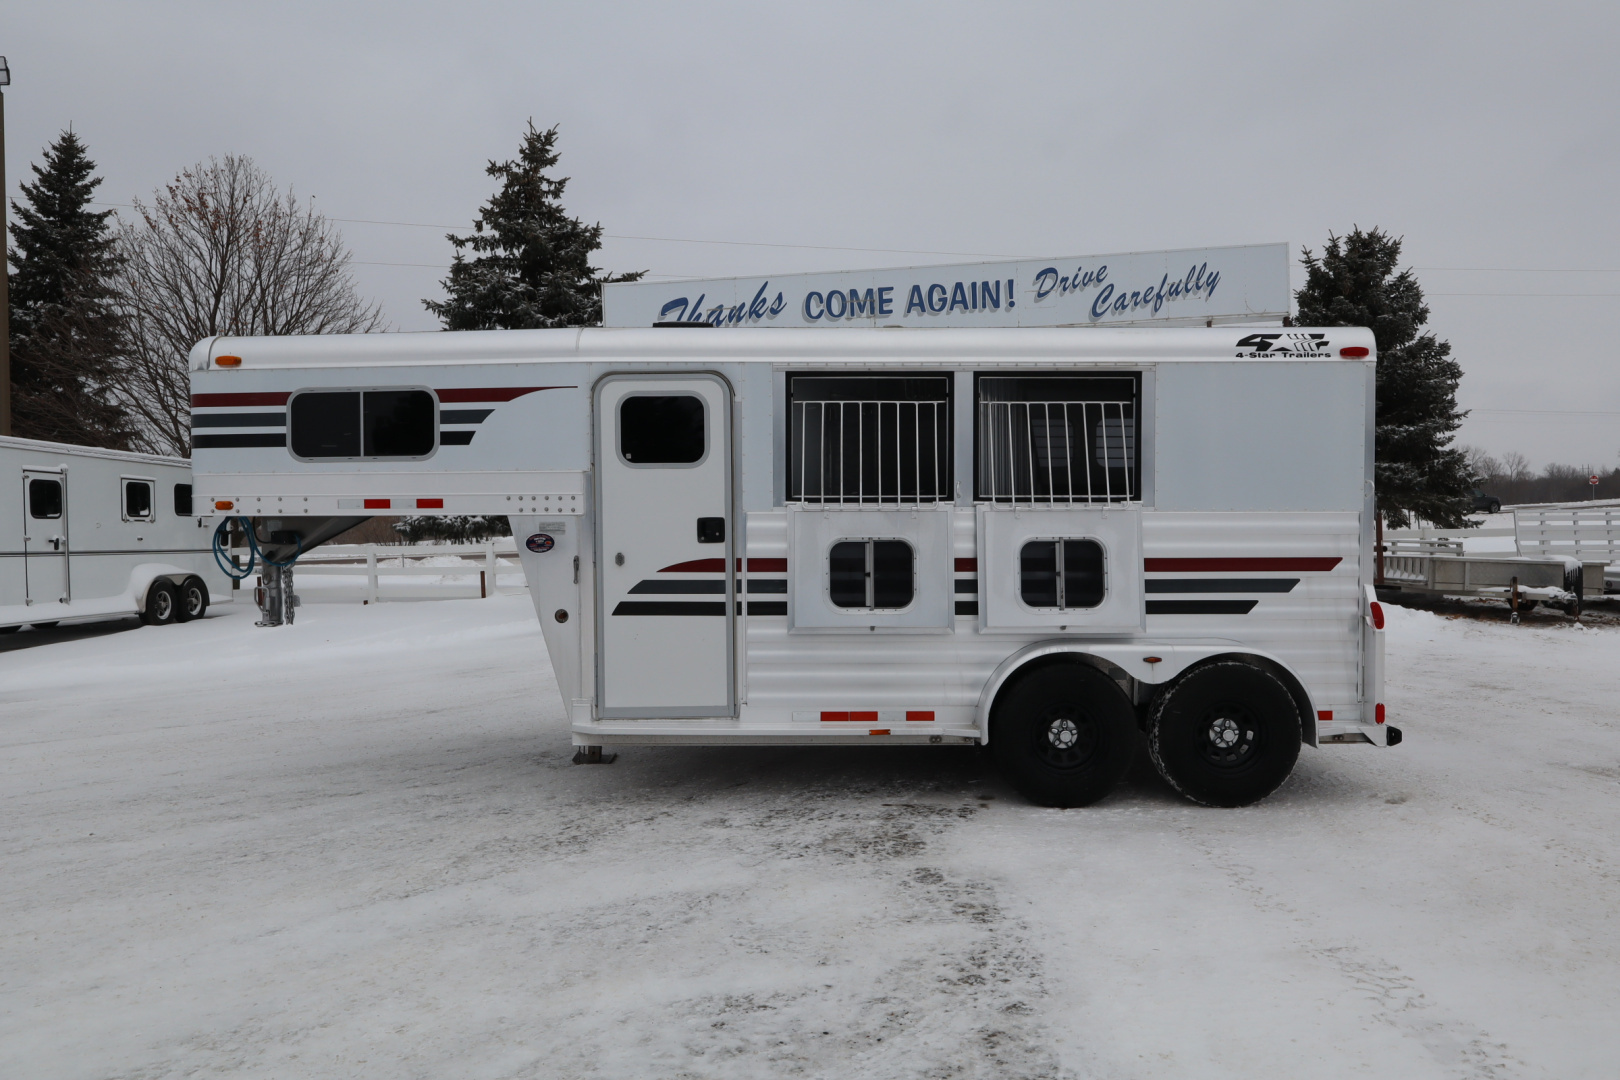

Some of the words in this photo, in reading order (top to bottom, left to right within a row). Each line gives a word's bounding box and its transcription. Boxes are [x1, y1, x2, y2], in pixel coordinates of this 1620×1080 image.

[1034, 264, 1108, 299] Drive
[1091, 261, 1222, 318] Carefully
[660, 280, 788, 328] Thanks
[803, 286, 895, 320] COME
[906, 278, 1015, 314] AGAIN!
[1235, 351, 1276, 359] 4-Star
[1281, 351, 1332, 359] Trailers
